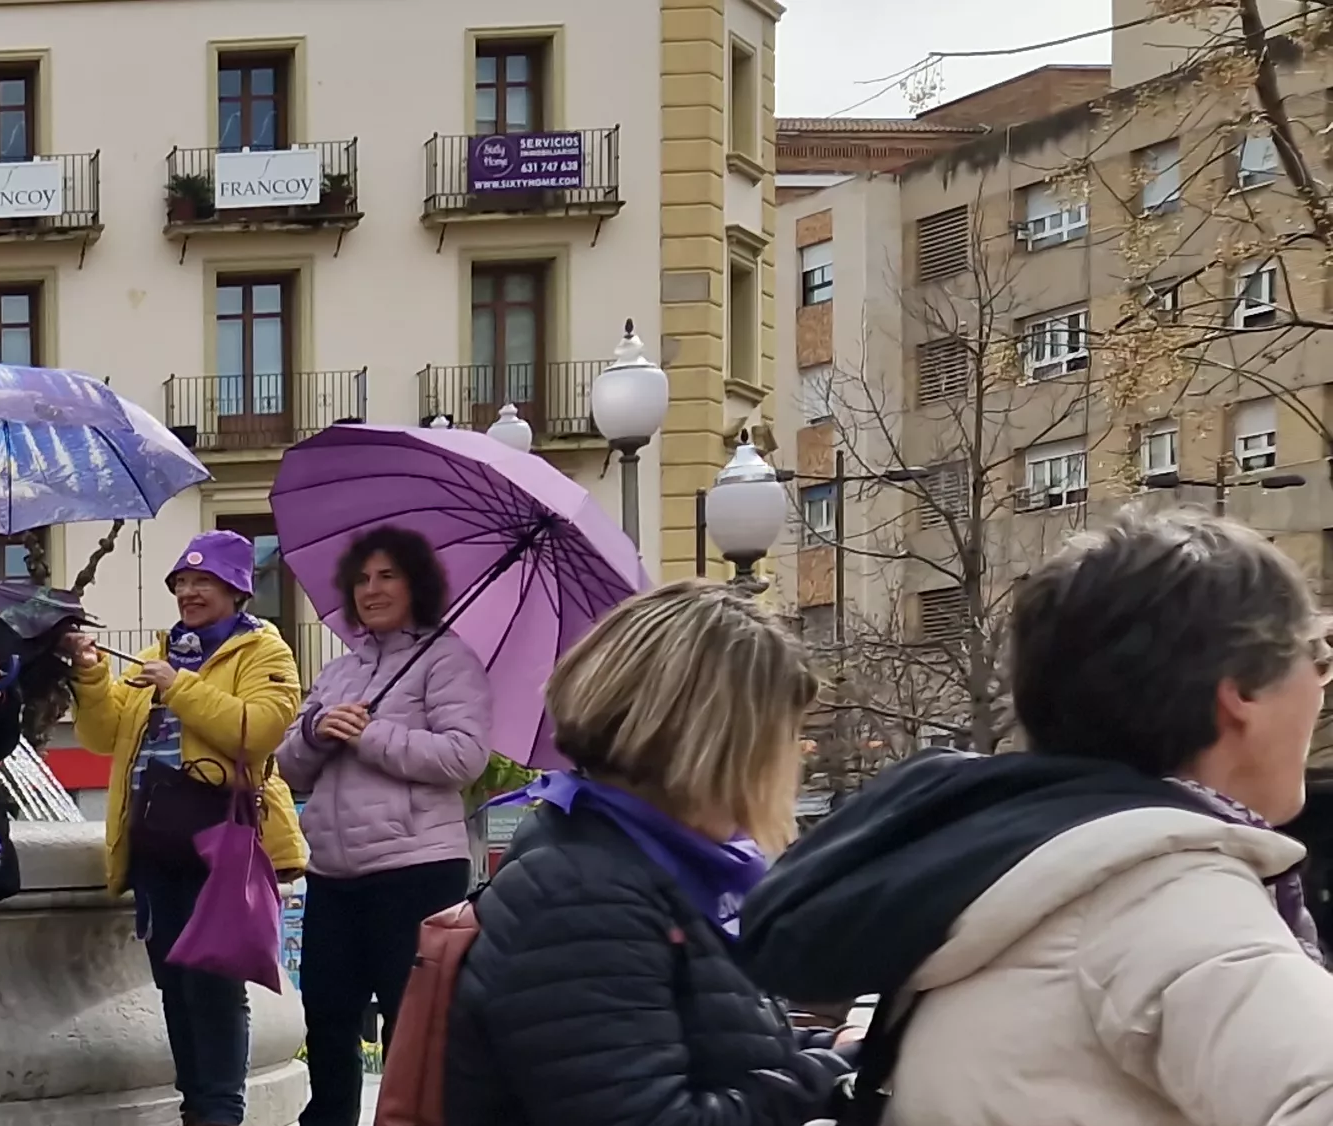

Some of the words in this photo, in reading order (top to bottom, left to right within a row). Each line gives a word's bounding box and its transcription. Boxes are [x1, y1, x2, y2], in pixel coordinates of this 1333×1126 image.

[520, 137, 579, 149] SERVICIOS
[521, 163, 537, 173] 631
[541, 162, 558, 172] 747
